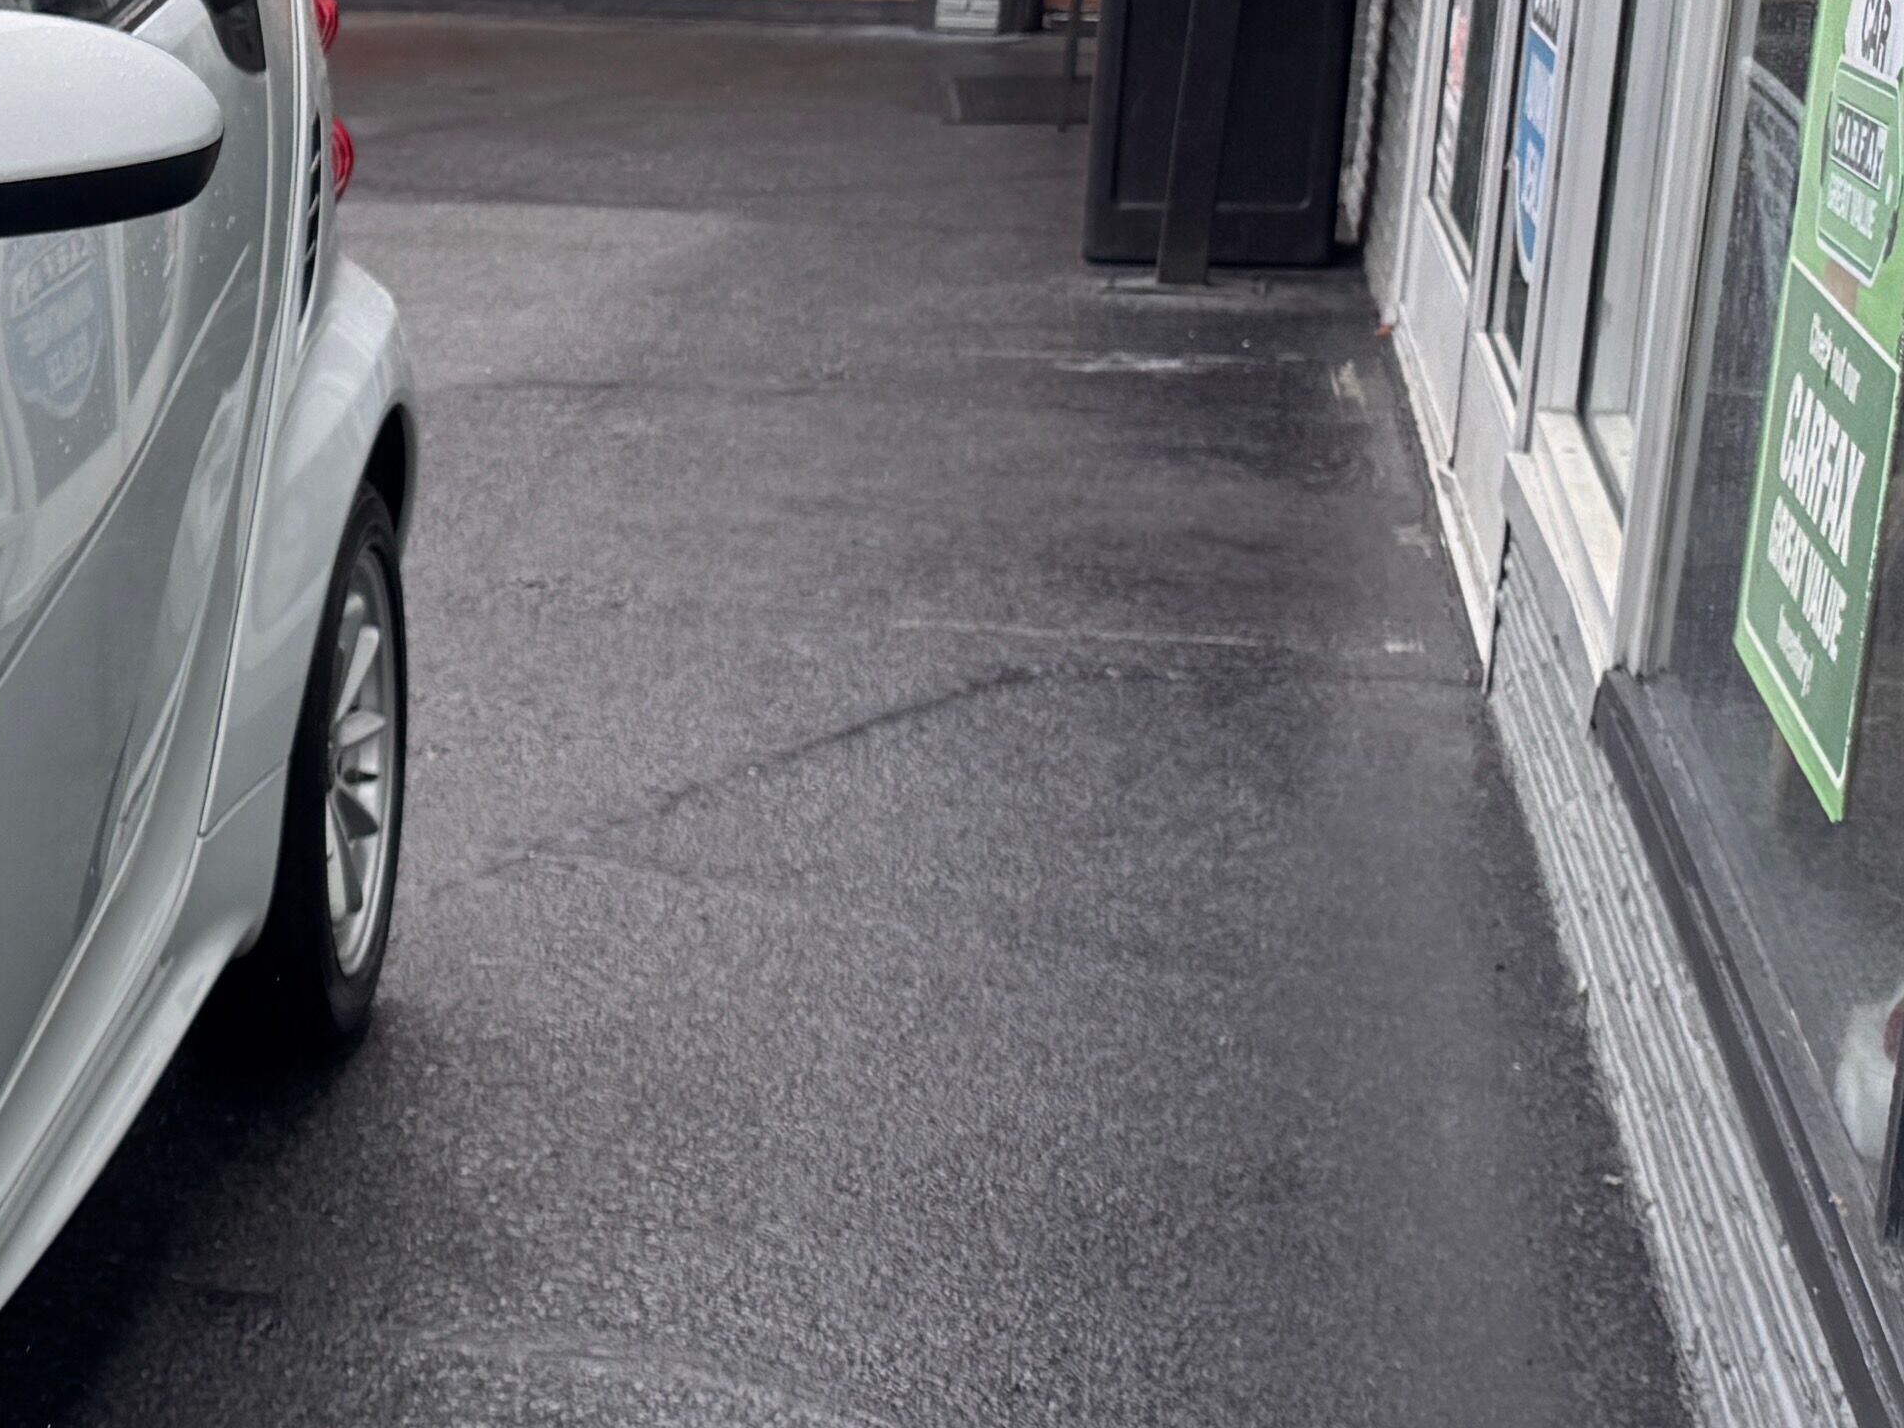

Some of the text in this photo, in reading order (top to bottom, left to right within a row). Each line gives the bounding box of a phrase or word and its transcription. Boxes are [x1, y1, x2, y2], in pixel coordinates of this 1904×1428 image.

[1833, 108, 1885, 186] CARFAX
[1778, 372, 1866, 568] CARFAX
[1801, 544, 1848, 664] VALUE
